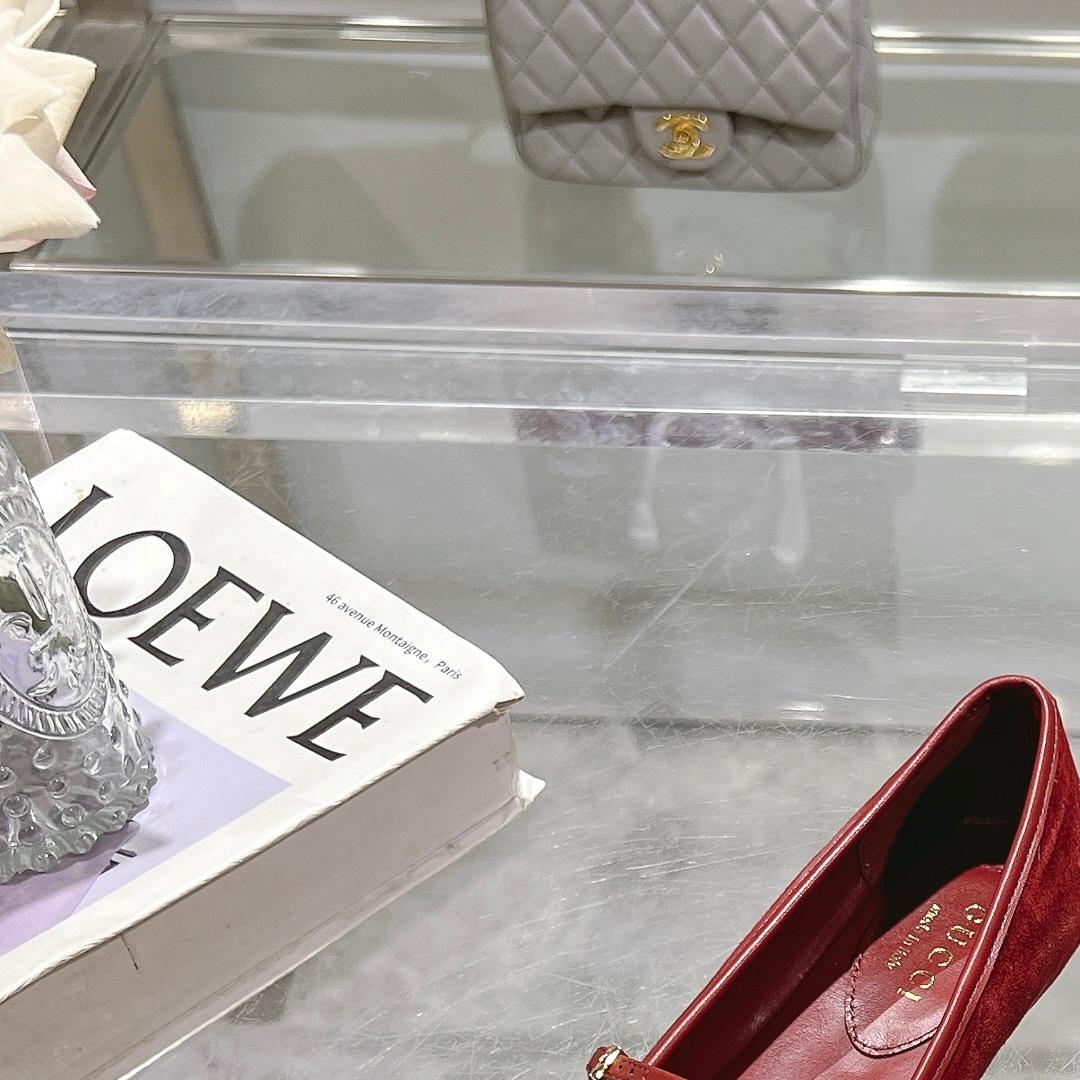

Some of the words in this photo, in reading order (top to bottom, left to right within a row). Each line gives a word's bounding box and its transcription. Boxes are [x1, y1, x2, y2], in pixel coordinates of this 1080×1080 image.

[325, 593, 342, 606] 46
[337, 602, 376, 629] avenue
[373, 623, 431, 664] Montaigne,
[434, 660, 463, 680] Paris
